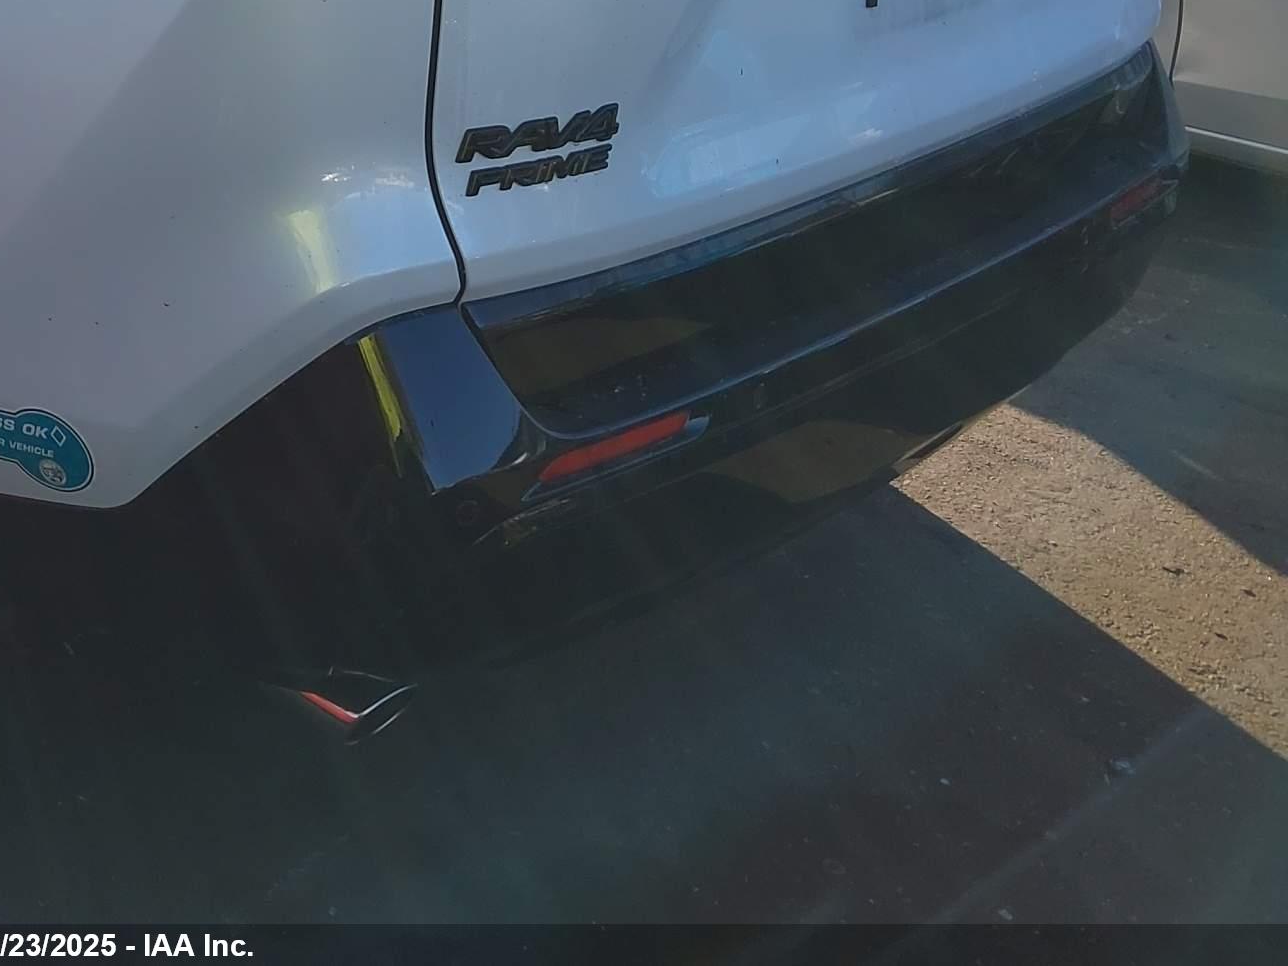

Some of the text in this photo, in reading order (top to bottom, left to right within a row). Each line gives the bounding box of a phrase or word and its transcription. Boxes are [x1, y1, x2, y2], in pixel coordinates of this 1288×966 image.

[455, 102, 620, 163] RAV4
[465, 143, 613, 197] PRIME
[9, 440, 54, 458] VEHICLE
[22, 423, 49, 439] OK
